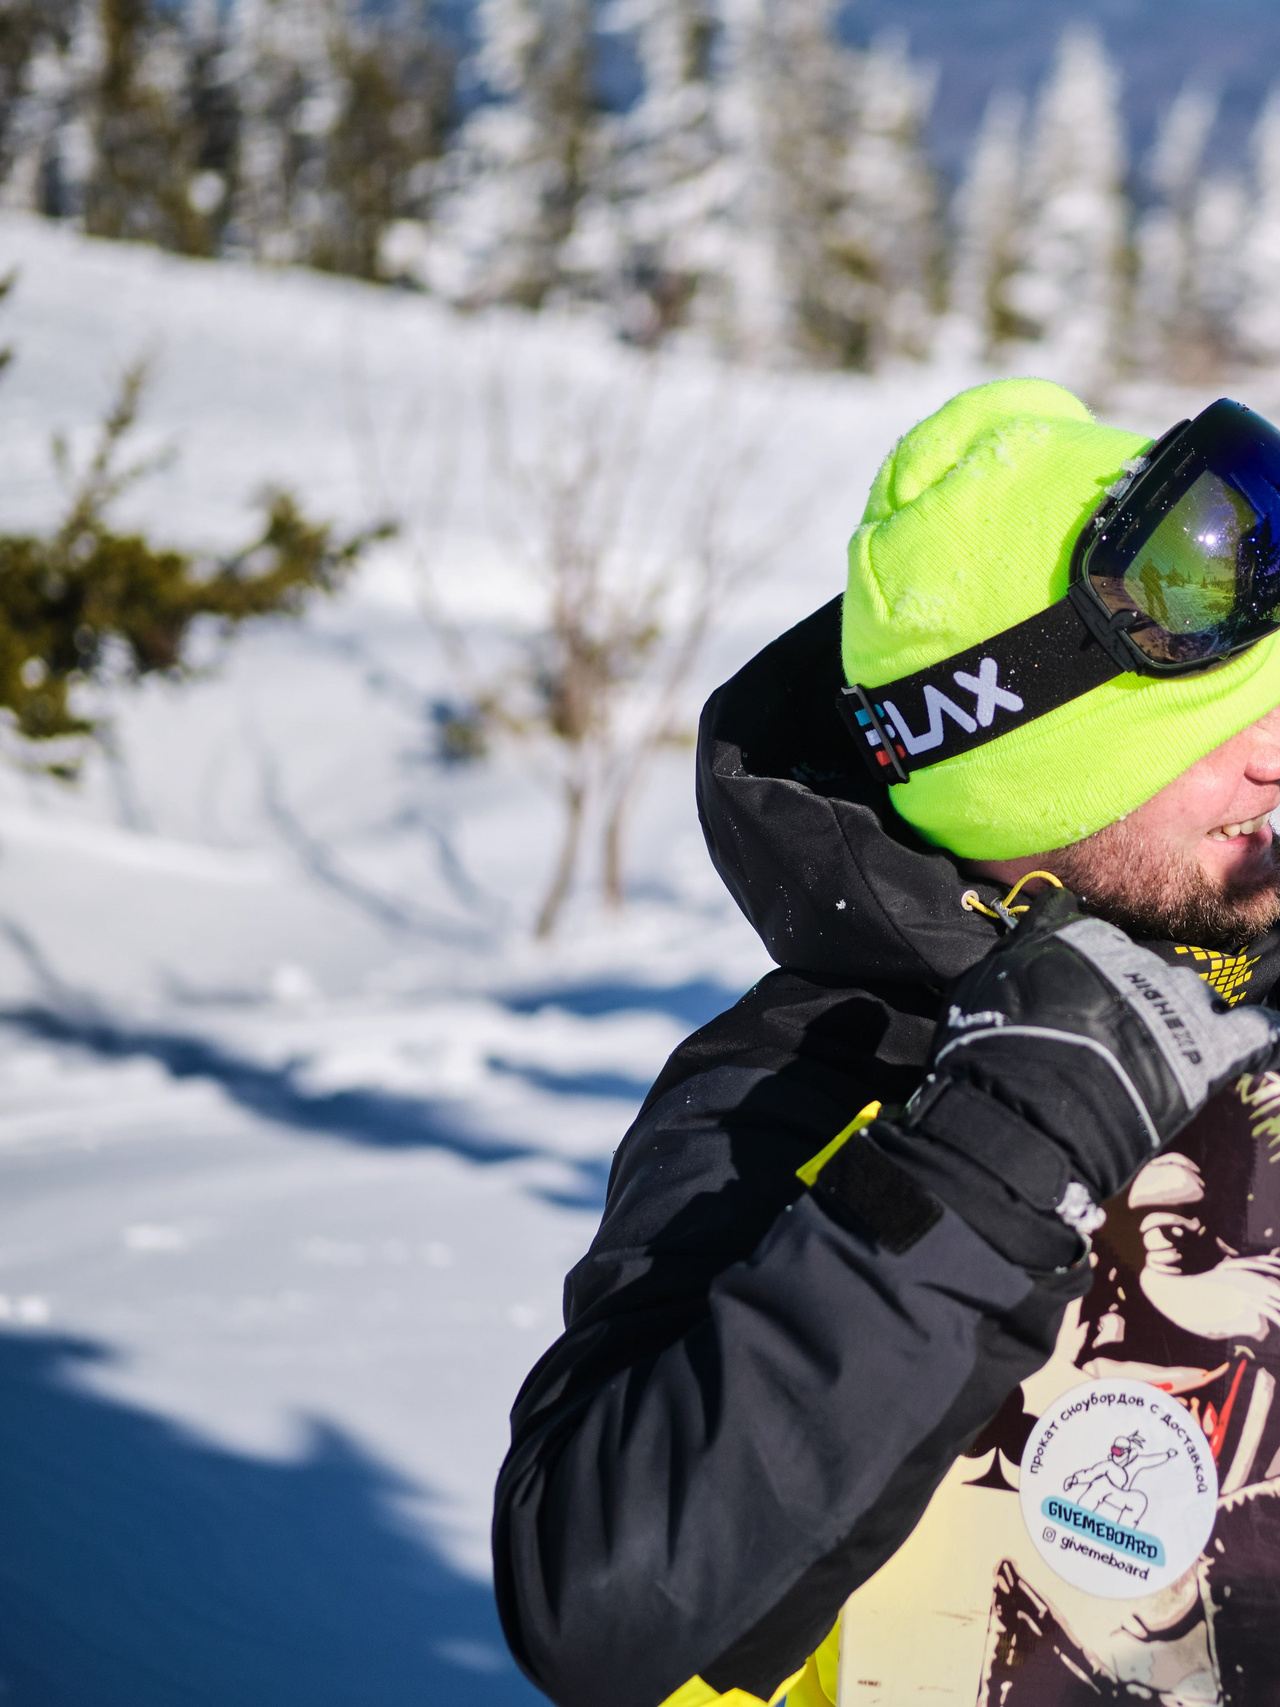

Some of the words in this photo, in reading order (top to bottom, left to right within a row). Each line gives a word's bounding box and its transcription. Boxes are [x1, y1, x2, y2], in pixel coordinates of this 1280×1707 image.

[1030, 1421, 1059, 1474] прокат
[1060, 1392, 1145, 1422] сноубордов
[1150, 1404, 1159, 1414] с
[1160, 1412, 1208, 1494] доставкой
[1048, 1501, 1159, 1560] GIVEMEBOARD
[1060, 1534, 1150, 1580] givemeboard
